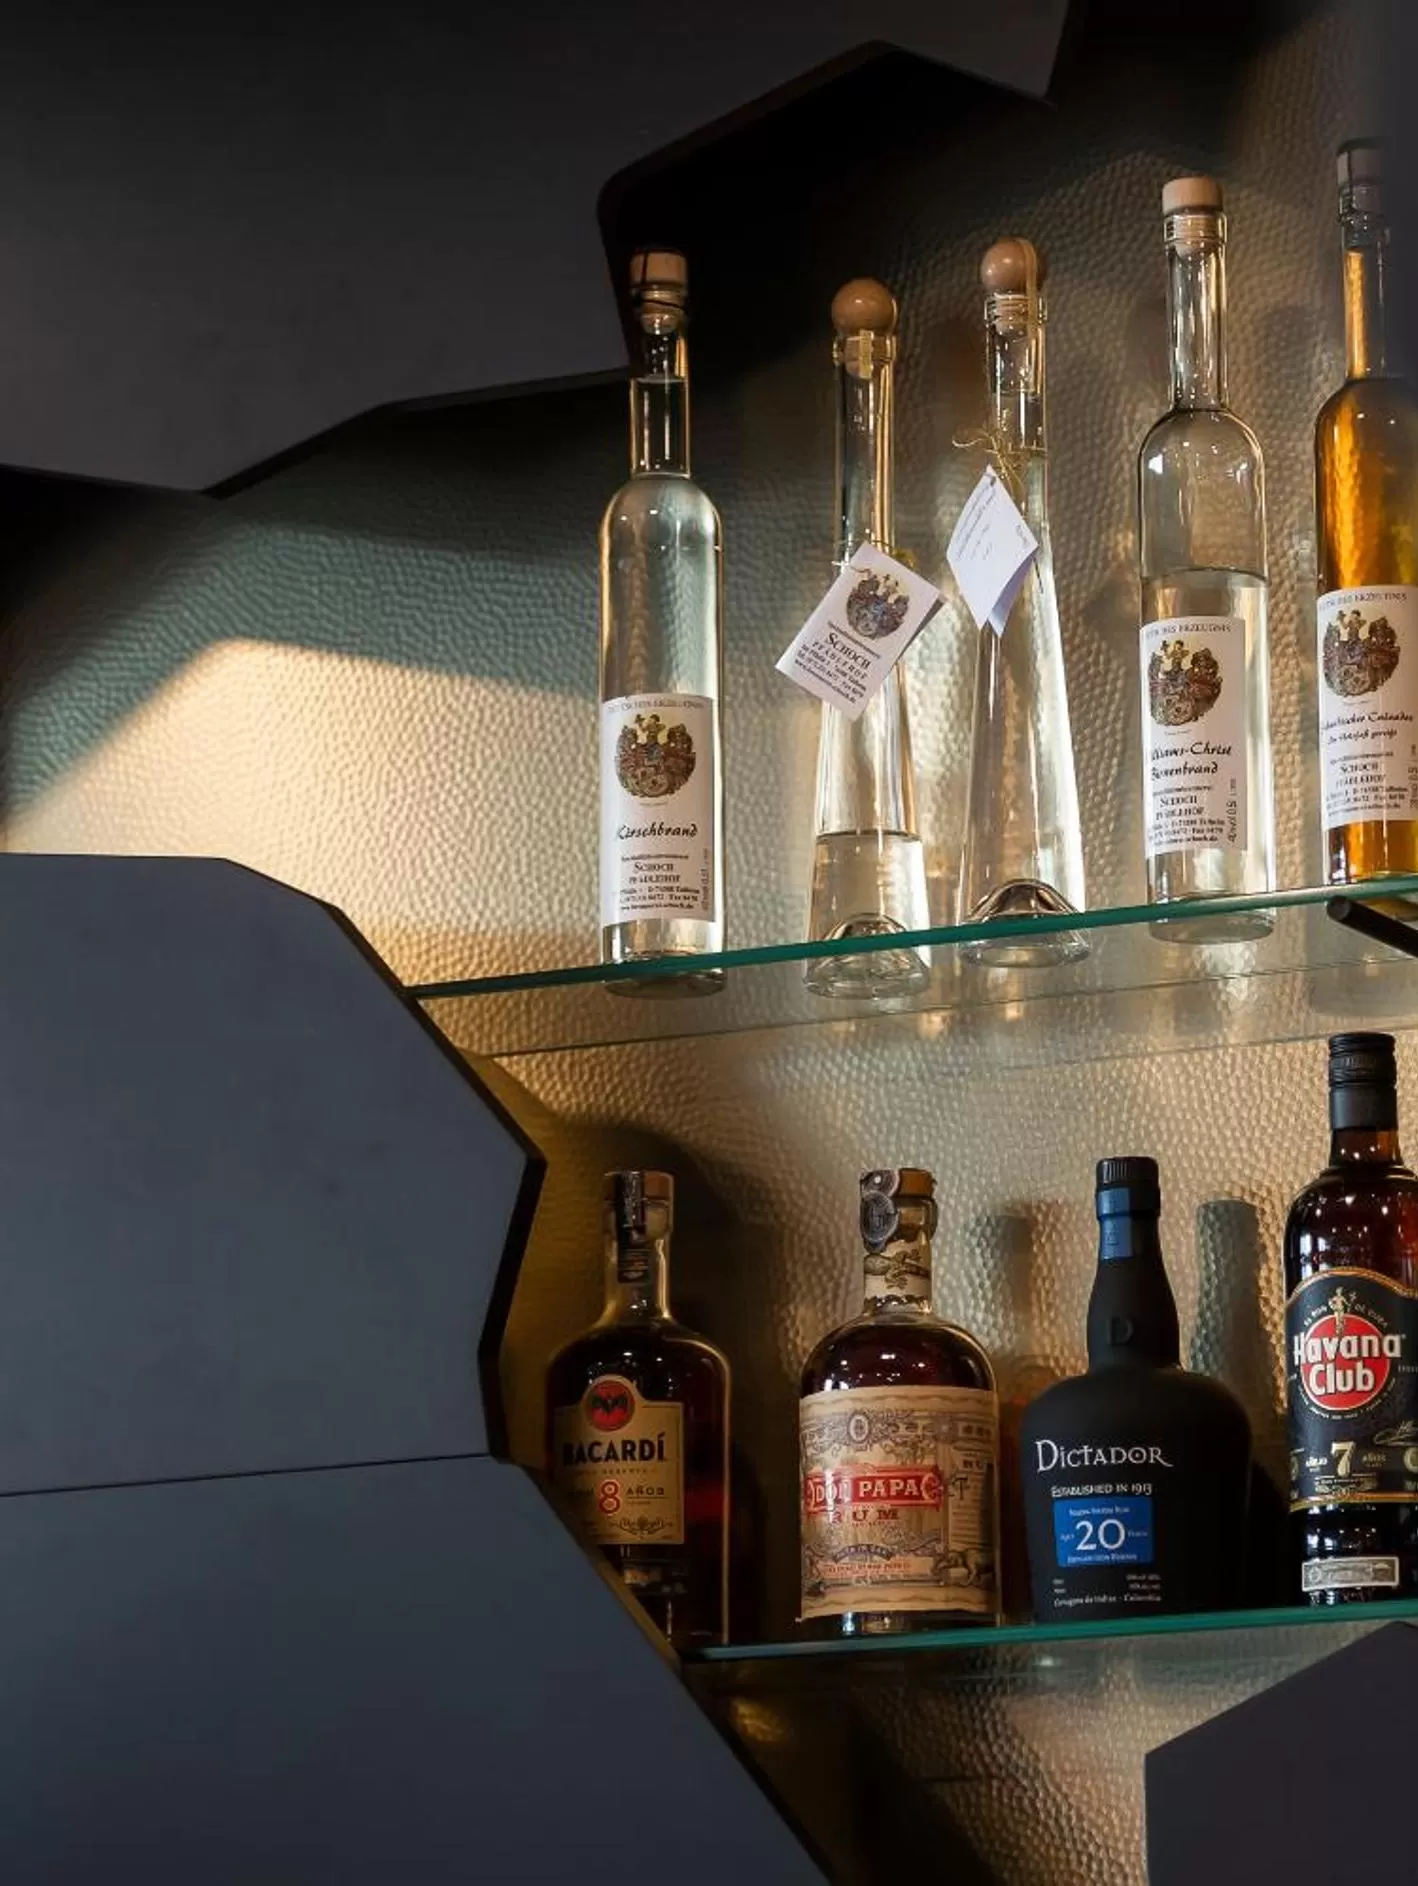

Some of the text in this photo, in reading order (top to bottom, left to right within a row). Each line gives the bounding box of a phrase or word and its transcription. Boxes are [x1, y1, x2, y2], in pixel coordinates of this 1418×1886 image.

[1293, 1332, 1402, 1366] Havana
[1309, 1360, 1375, 1396] Club
[563, 1432, 667, 1465] BACARDÍ
[1331, 1441, 1356, 1476] 7
[600, 1479, 621, 1514] 8
[859, 1479, 920, 1498] PAPA
[1075, 1518, 1126, 1551] 20
